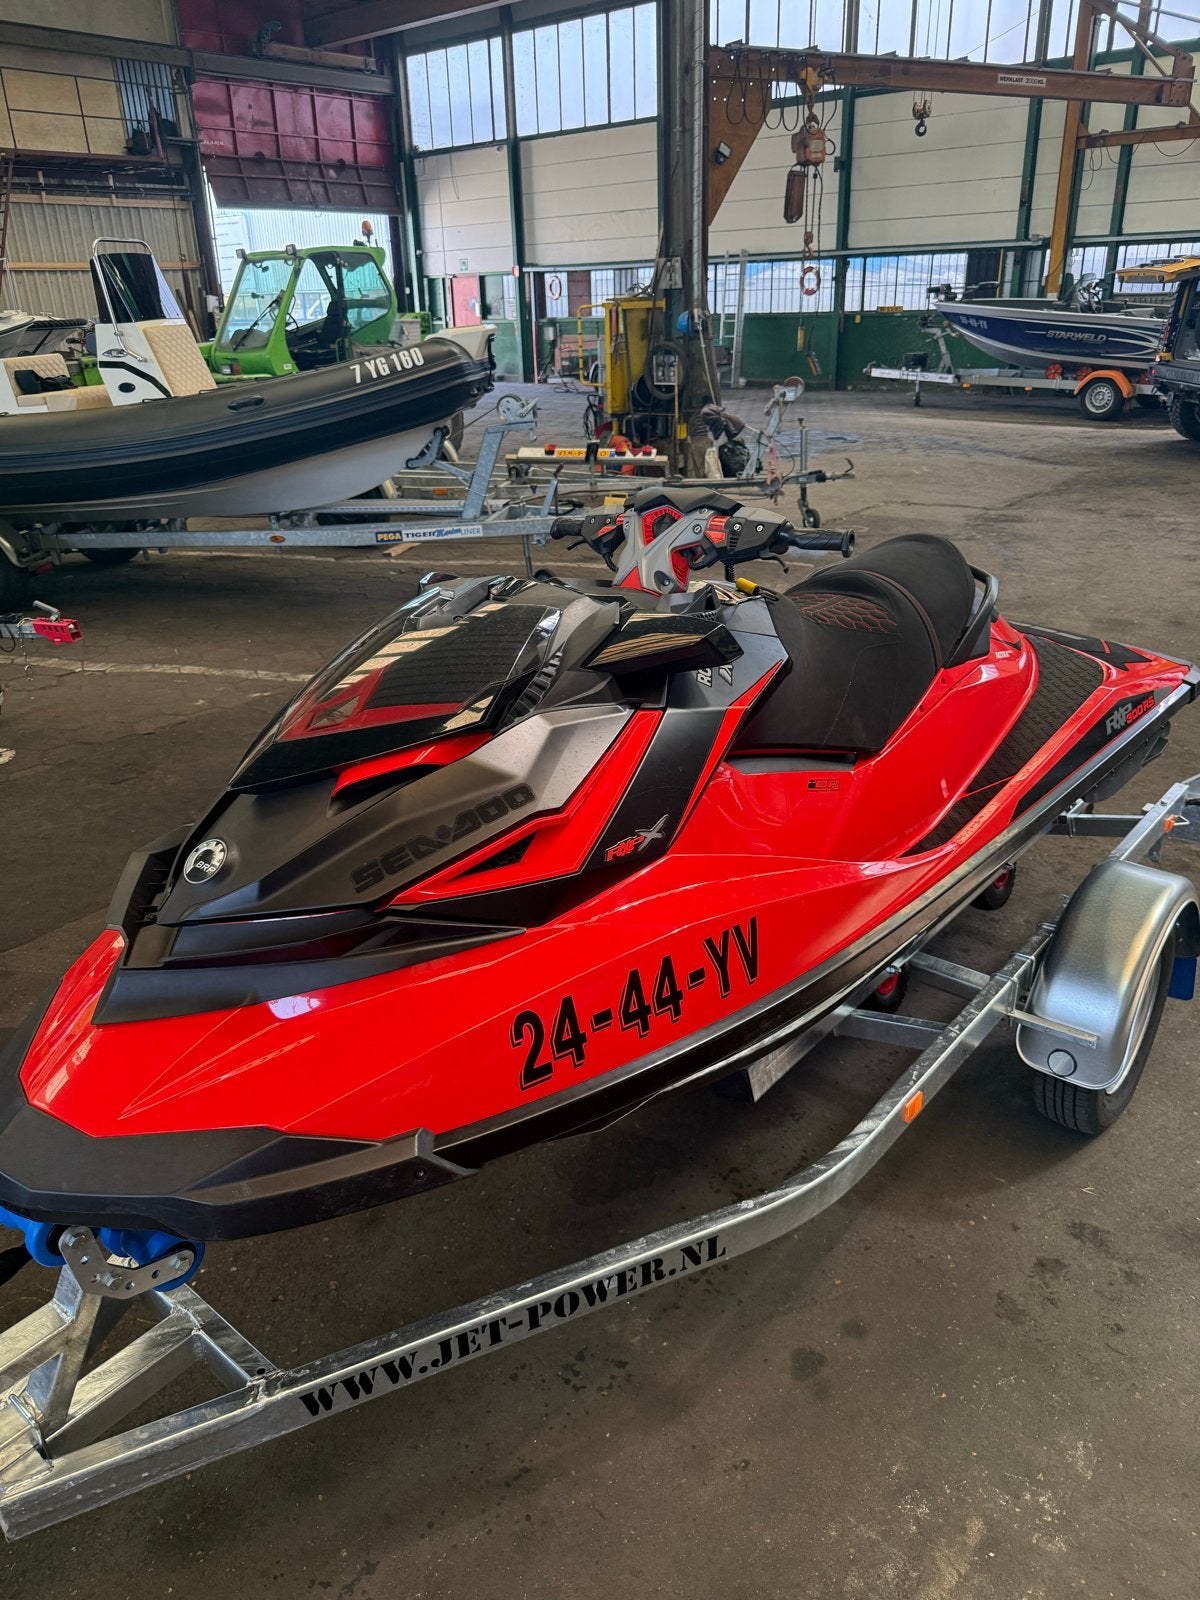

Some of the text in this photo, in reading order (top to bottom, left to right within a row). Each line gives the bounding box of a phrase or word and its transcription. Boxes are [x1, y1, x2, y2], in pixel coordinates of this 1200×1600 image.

[1046, 330, 1107, 342] STARWELD
[349, 347, 425, 384] 7 YG 160
[376, 533, 402, 541] PEGA
[196, 860, 217, 873] BRP
[509, 915, 759, 1092] 24-44-YV
[299, 1235, 727, 1418] WWW.JET-POWER.NL
